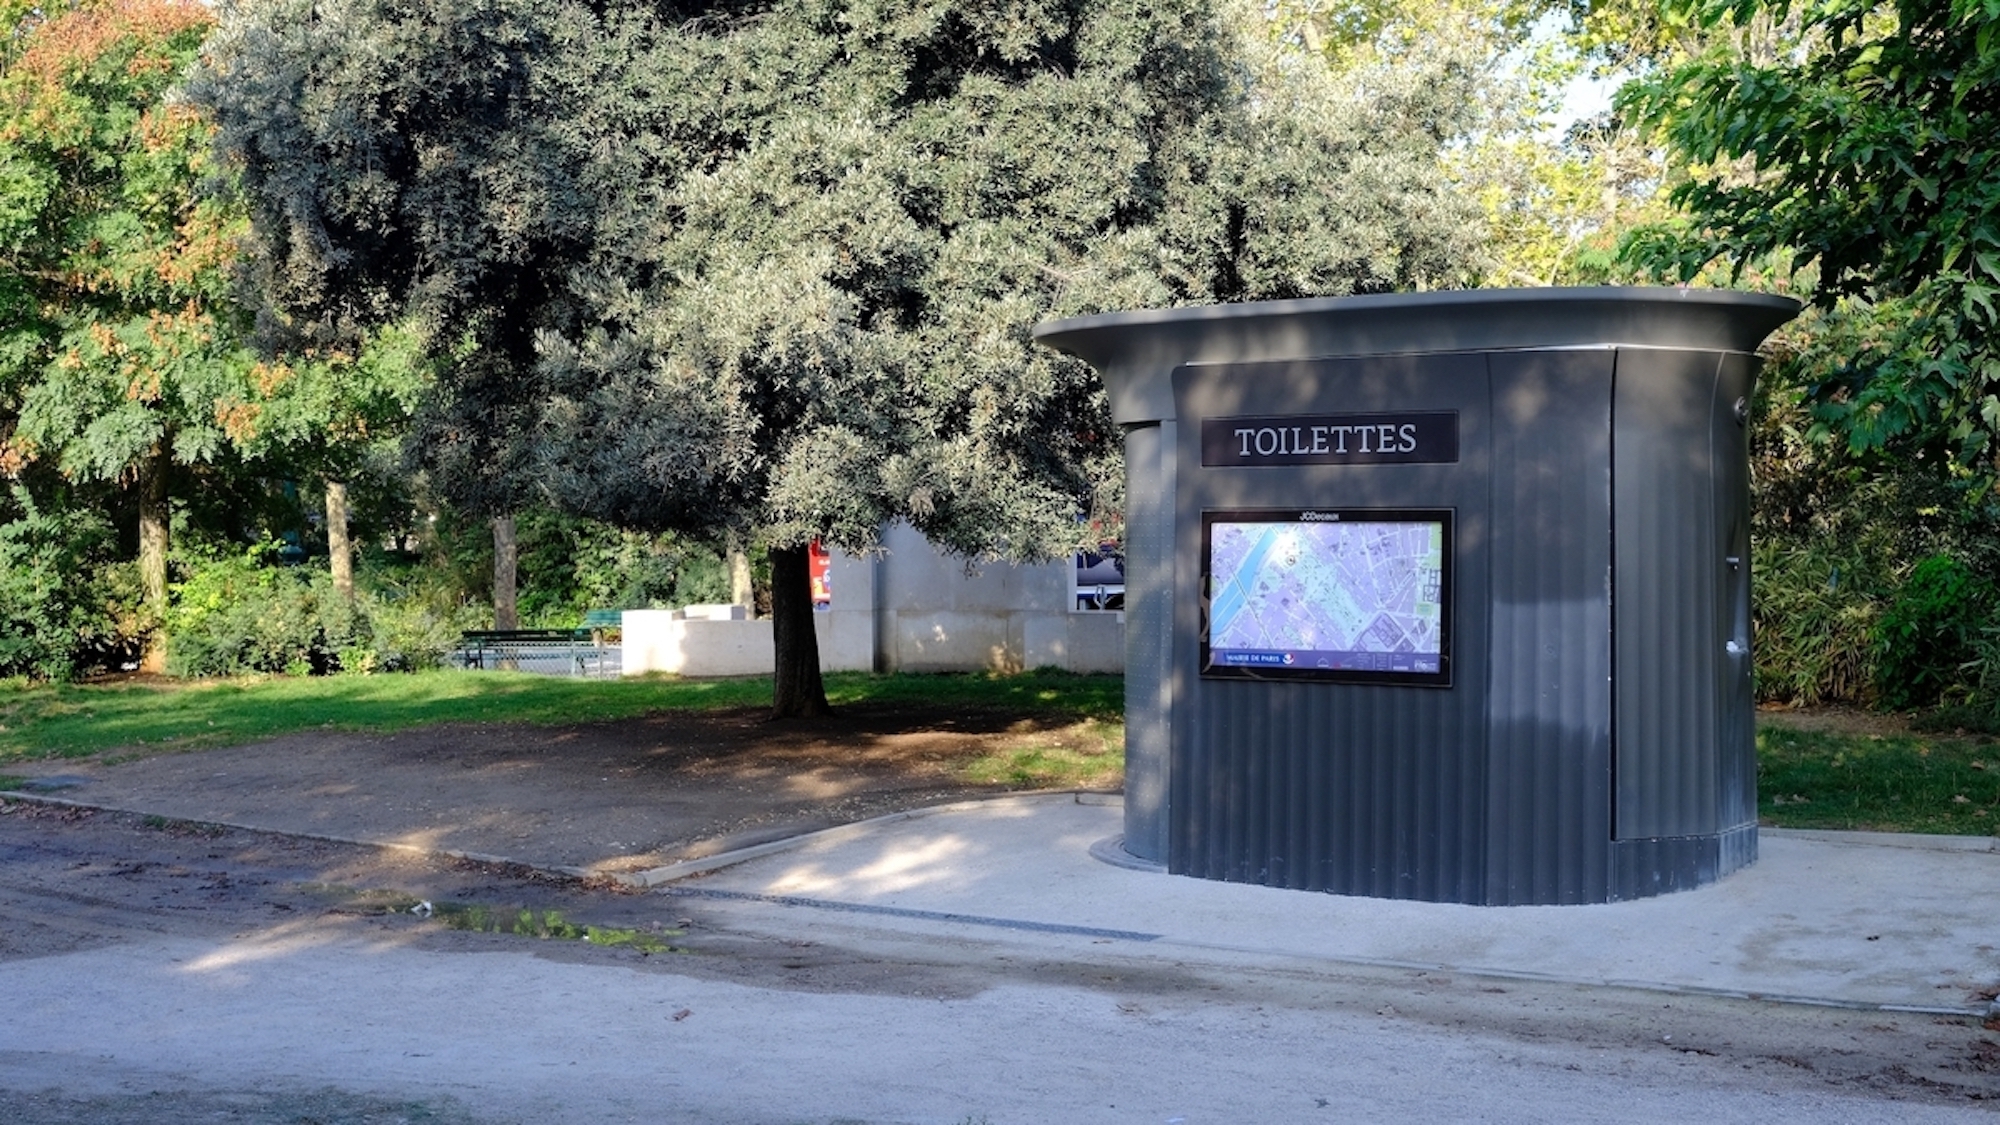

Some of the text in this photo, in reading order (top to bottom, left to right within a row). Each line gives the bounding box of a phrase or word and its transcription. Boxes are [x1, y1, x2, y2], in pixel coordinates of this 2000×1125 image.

[1234, 424, 1417, 456] TOILETTES
[1251, 654, 1260, 662] DE
[1261, 655, 1280, 663] PARIS
